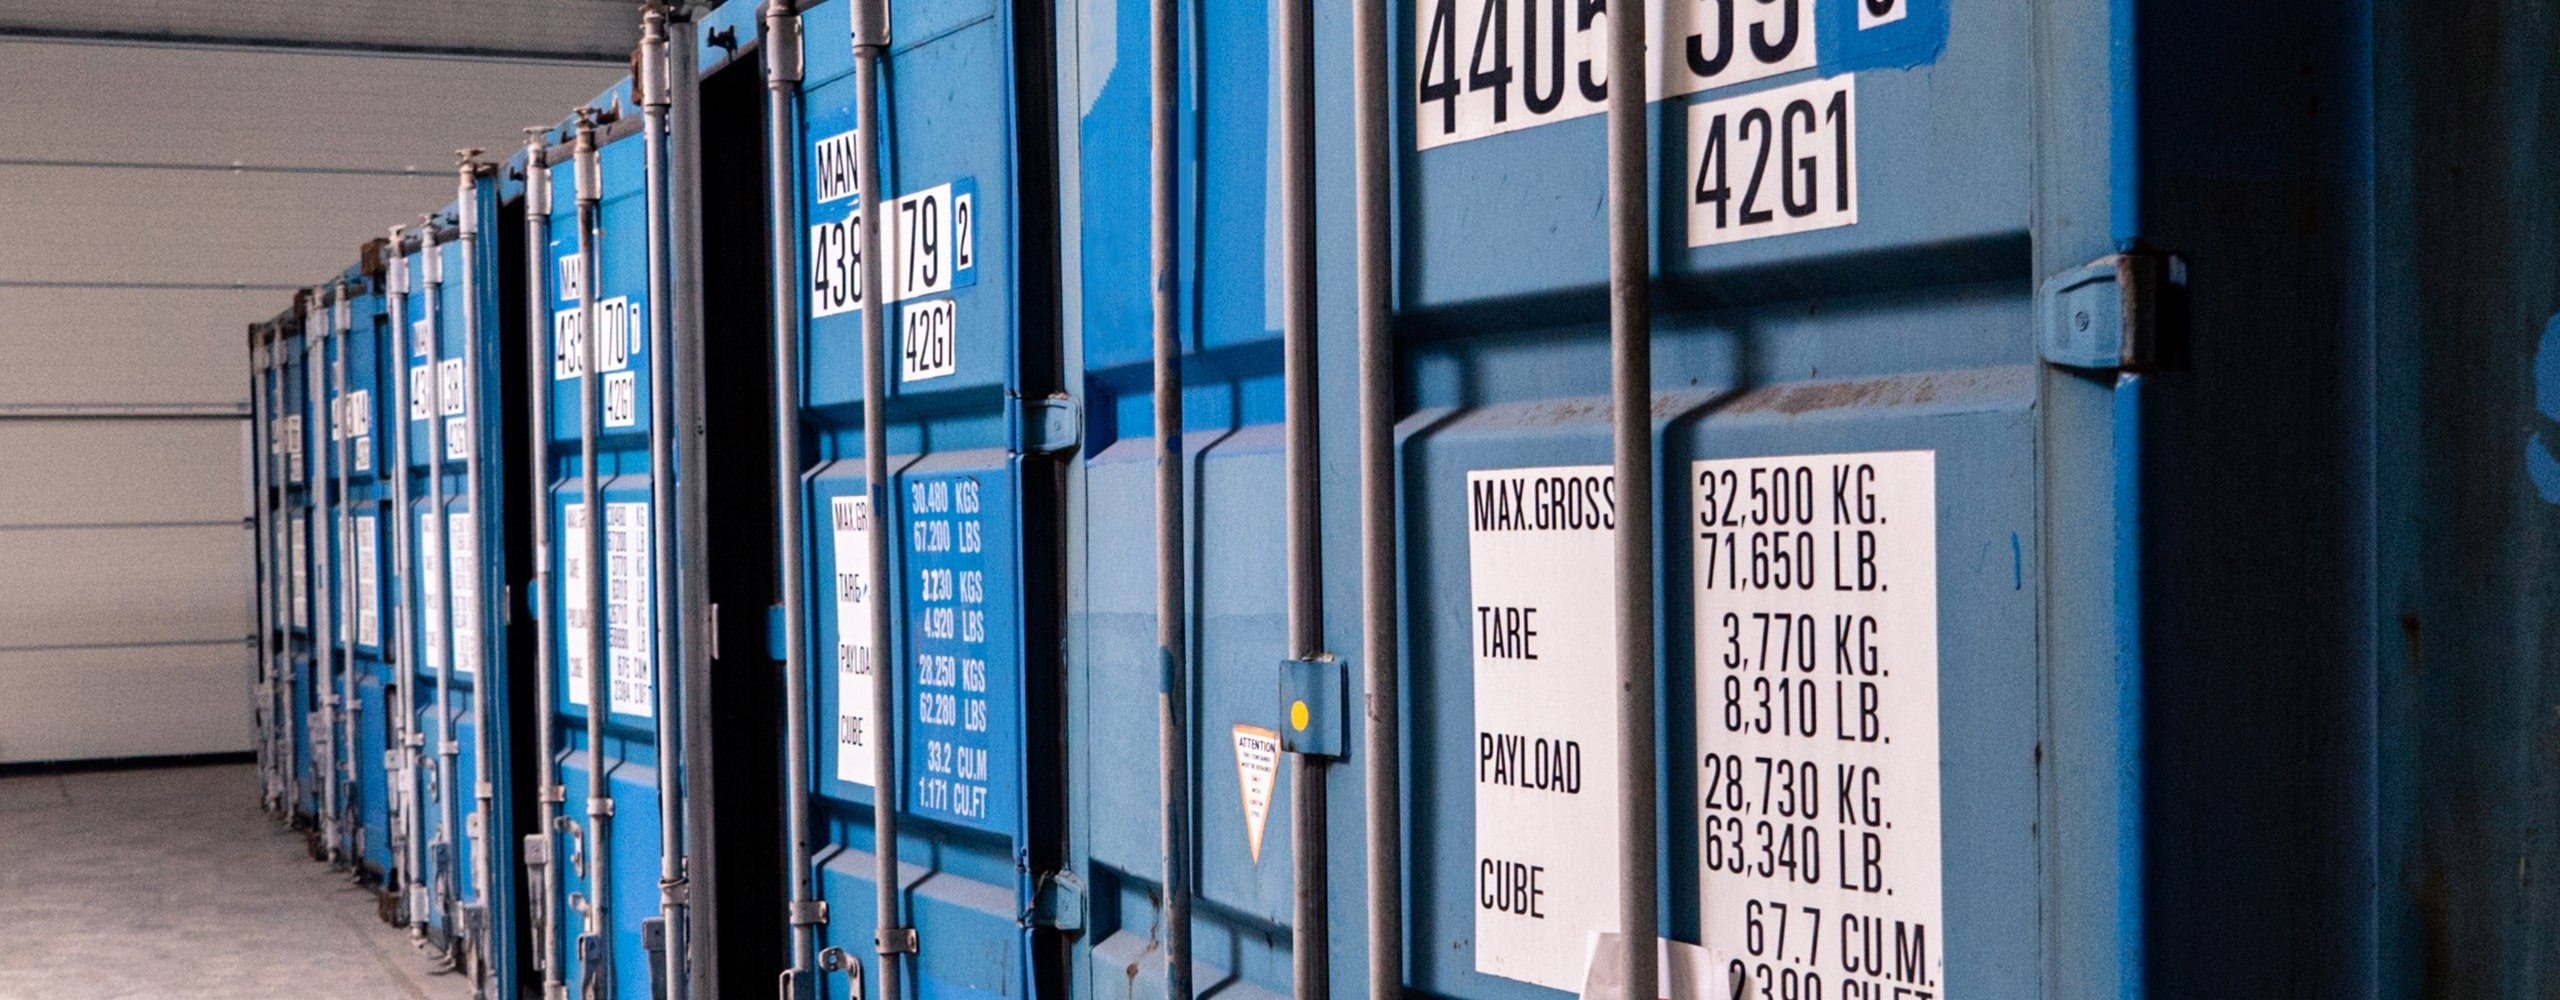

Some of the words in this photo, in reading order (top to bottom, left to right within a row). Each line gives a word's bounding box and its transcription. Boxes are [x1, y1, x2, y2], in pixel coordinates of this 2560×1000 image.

[1694, 90, 1849, 229] 42G1
[902, 195, 938, 292] 79
[958, 202, 969, 265] 2
[605, 302, 625, 366] 70
[905, 303, 952, 373] 42G1
[607, 378, 633, 421] 42G1
[911, 481, 948, 514] 30.480
[955, 480, 979, 514] KGS
[1473, 475, 1615, 532] MAX.GROSS
[1699, 466, 1813, 528] 32,500
[1833, 464, 1886, 525] KG.
[914, 520, 950, 552] 67.200
[958, 520, 981, 553] LBS
[1700, 531, 1814, 592] 71,650
[1834, 530, 1887, 592] LB.
[959, 570, 983, 604] KGS
[924, 607, 954, 639] 4.920
[962, 610, 985, 643] LBS
[1478, 606, 1538, 660] TARE
[1723, 612, 1816, 673] 3,770
[1835, 614, 1889, 677] KG.
[919, 654, 956, 688] 28.250
[962, 658, 986, 692] KGS
[920, 692, 956, 727] 62.280
[964, 698, 987, 733] LBS
[1724, 675, 1817, 738] 8,310
[1836, 680, 1890, 744] LB.
[840, 714, 863, 747] CUBE
[928, 740, 951, 774] 33.2
[957, 745, 987, 782] CU.M
[1239, 737, 1276, 753] ATTENTION
[919, 776, 947, 811] 1.171
[953, 782, 987, 819] CU.FT
[1479, 732, 1582, 795] PAYLOAD
[1704, 752, 1818, 820] 28,730
[1838, 764, 1891, 829] KG.
[1706, 815, 1820, 884] 63,340
[1839, 829, 1893, 896] LB.
[1480, 858, 1545, 920] CUBE
[1746, 899, 1821, 967] 67.7
[1841, 913, 1934, 988] CU.M.
